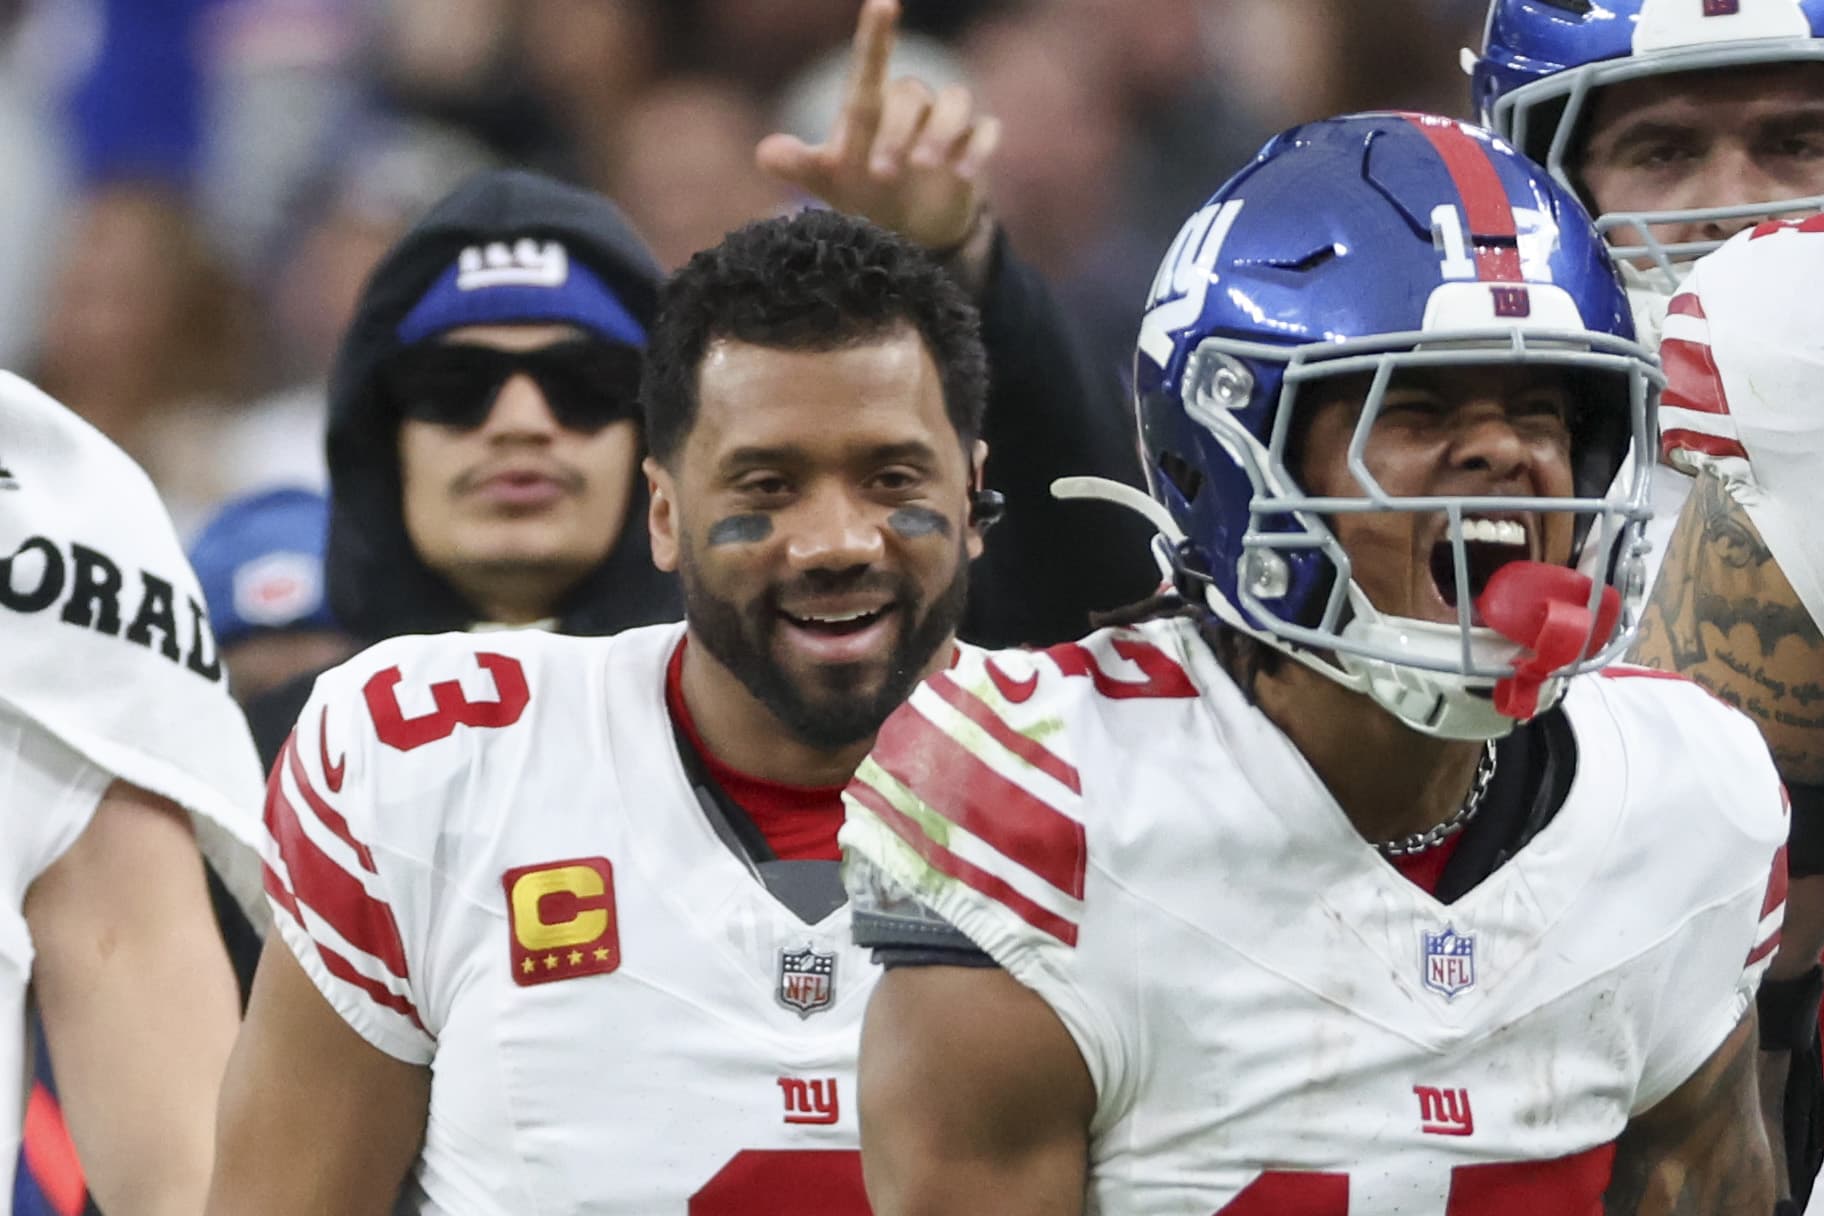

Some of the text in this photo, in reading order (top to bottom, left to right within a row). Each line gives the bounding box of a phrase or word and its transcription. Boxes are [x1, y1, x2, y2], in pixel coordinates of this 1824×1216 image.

[1430, 202, 1562, 284] 17
[361, 651, 531, 753] 3
[511, 865, 609, 951] C
[786, 974, 827, 1004] NFL
[1432, 956, 1470, 988] NFL
[776, 1075, 840, 1126] ny
[1412, 1084, 1475, 1138] ny
